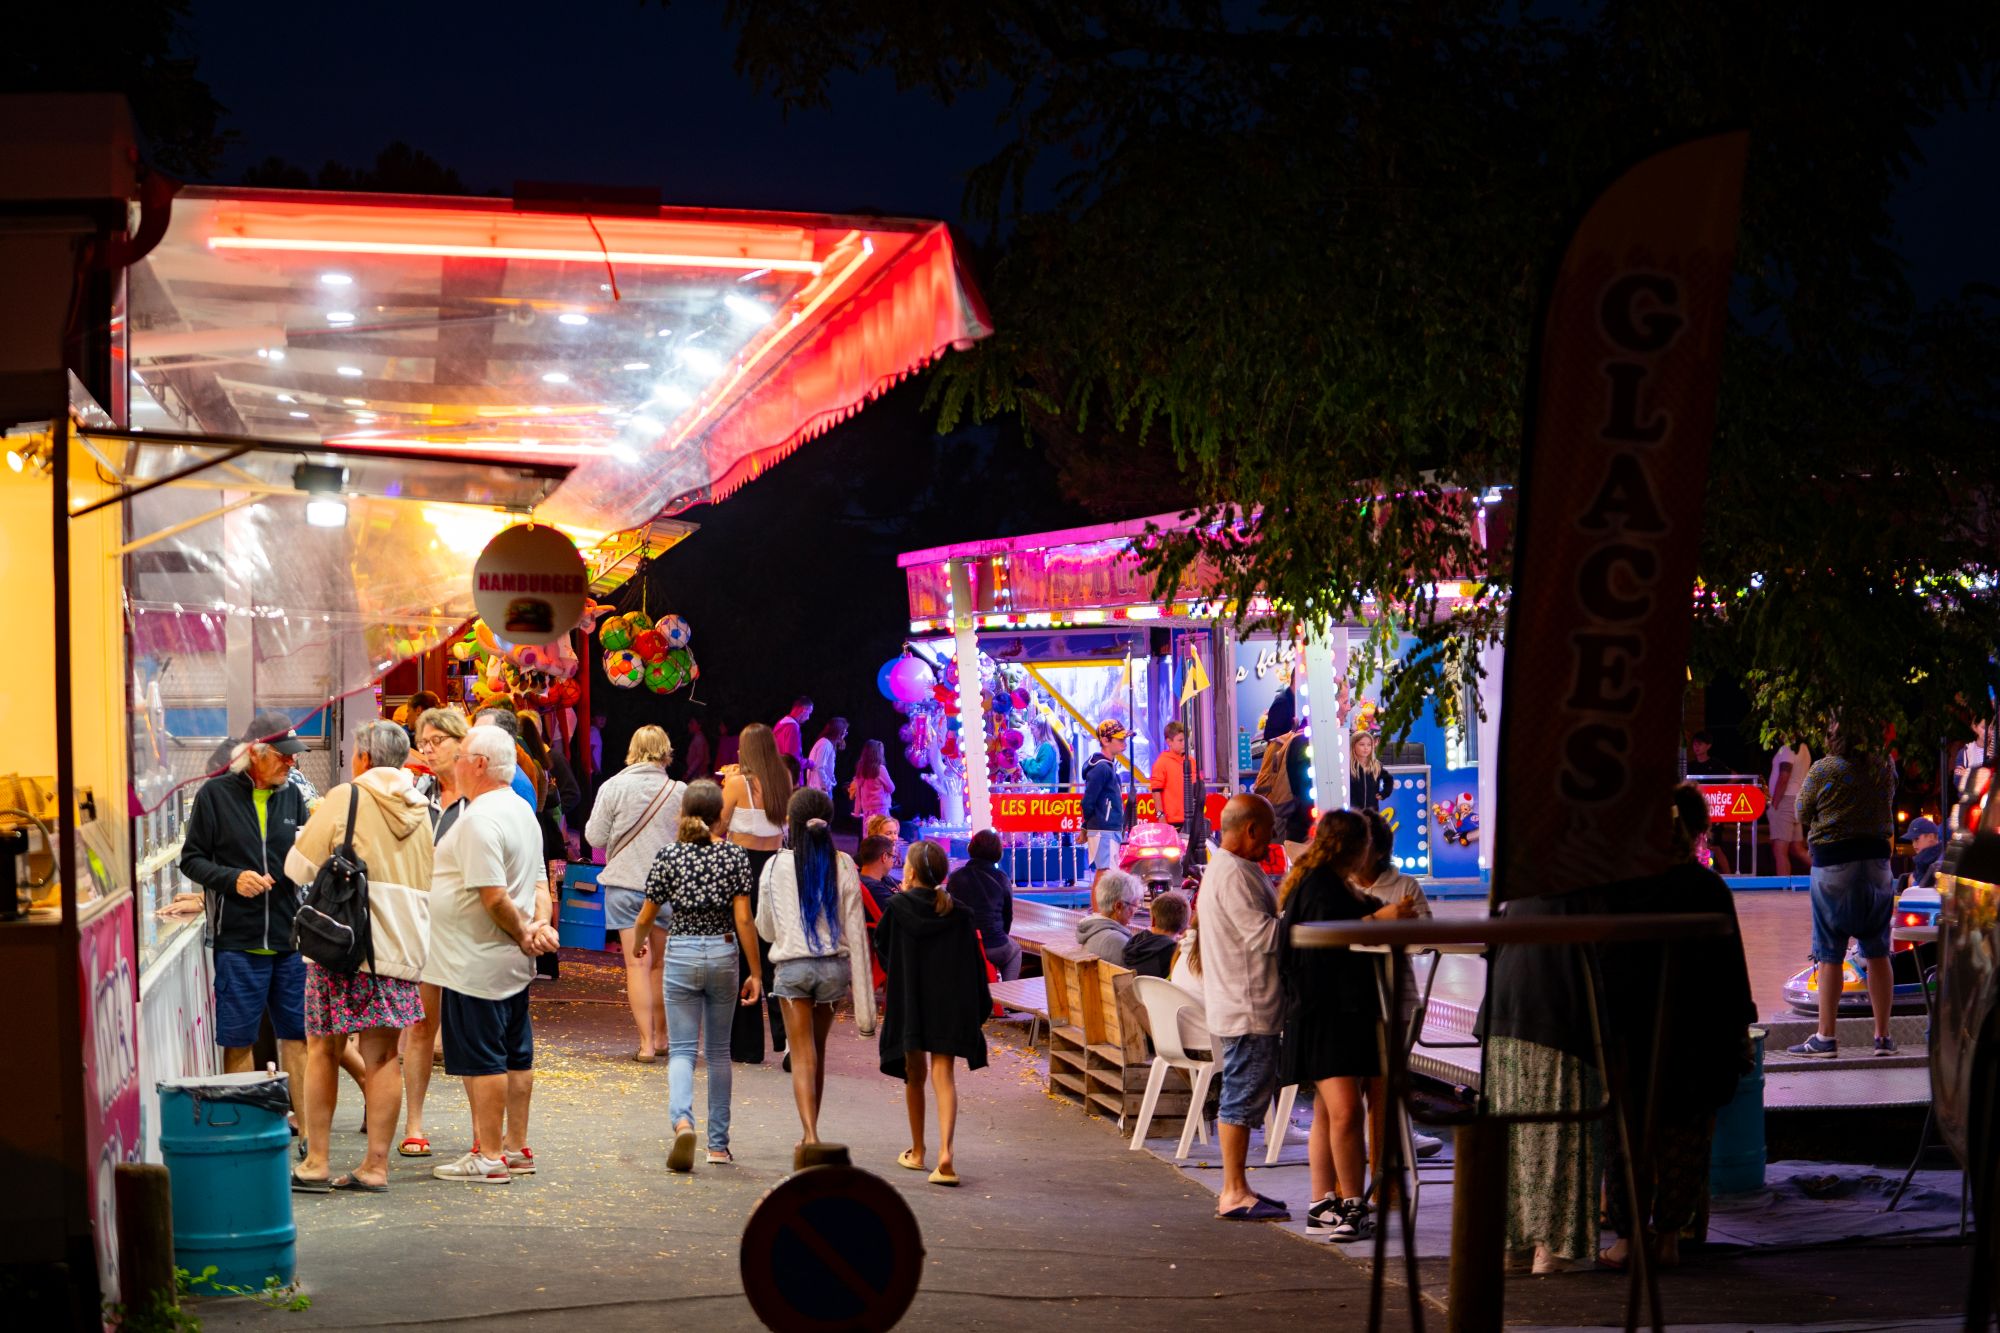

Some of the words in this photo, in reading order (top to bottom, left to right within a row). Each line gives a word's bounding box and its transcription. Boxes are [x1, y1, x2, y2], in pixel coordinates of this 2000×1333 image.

[1557, 268, 1688, 806] GLACES
[478, 571, 584, 593] HAMBURGER
[1702, 790, 1733, 805] ANÈGE
[1001, 799, 1026, 816] LES
[1030, 799, 1082, 816] PILOTE
[1060, 816, 1074, 829] de
